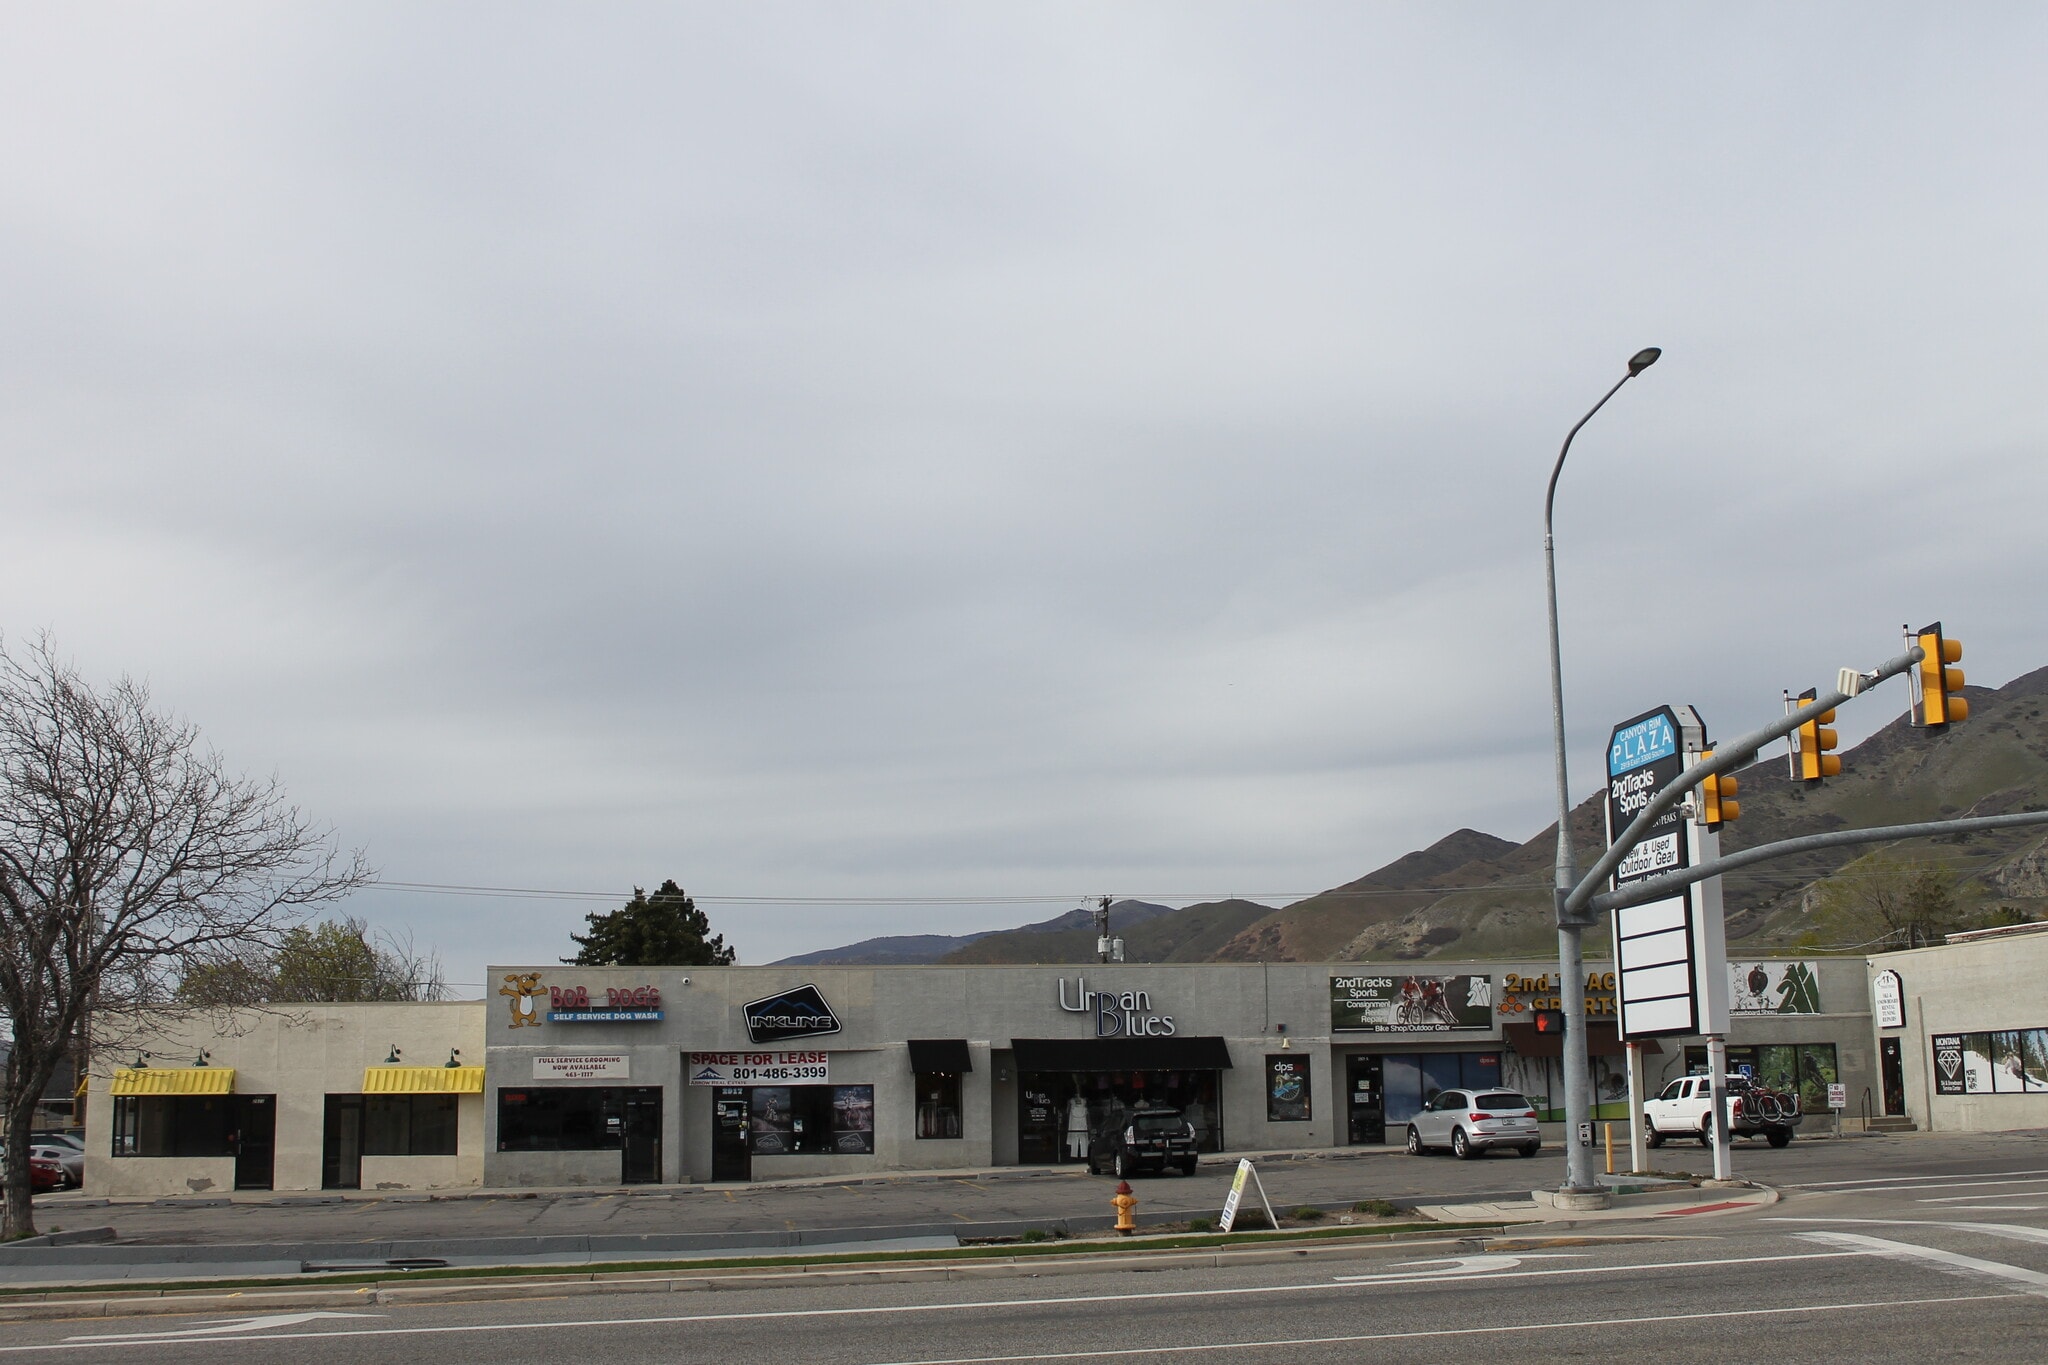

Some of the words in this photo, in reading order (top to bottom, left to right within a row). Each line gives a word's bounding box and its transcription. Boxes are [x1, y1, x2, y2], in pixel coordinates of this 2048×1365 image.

[1620, 723, 1647, 742] CANYON
[1648, 717, 1661, 731] RIM
[1612, 725, 1672, 764] PLAZA
[1611, 769, 1654, 799] 2ndTracks
[1620, 788, 1648, 817] Sports
[1651, 837, 1670, 853] Used
[1620, 857, 1652, 875] Outdoor
[1655, 850, 1676, 866] Gear
[1335, 977, 1393, 988] 2ndTracks
[1505, 973, 1550, 992] 2nd
[550, 986, 589, 1008] BOB
[606, 984, 661, 1007] DOG'S
[1350, 988, 1378, 999] Sports
[1346, 1000, 1391, 1010] Consignment
[750, 1015, 832, 1029] INKLINE
[1096, 993, 1176, 1037] Blues
[1375, 1024, 1389, 1032] Bike
[1935, 1037, 1960, 1046] MONTANA
[690, 1053, 738, 1066] SPACE
[744, 1053, 773, 1065] FOR
[779, 1051, 827, 1064] LEASE
[733, 1066, 827, 1080] 801-486-3399
[1274, 1061, 1294, 1074] dps
